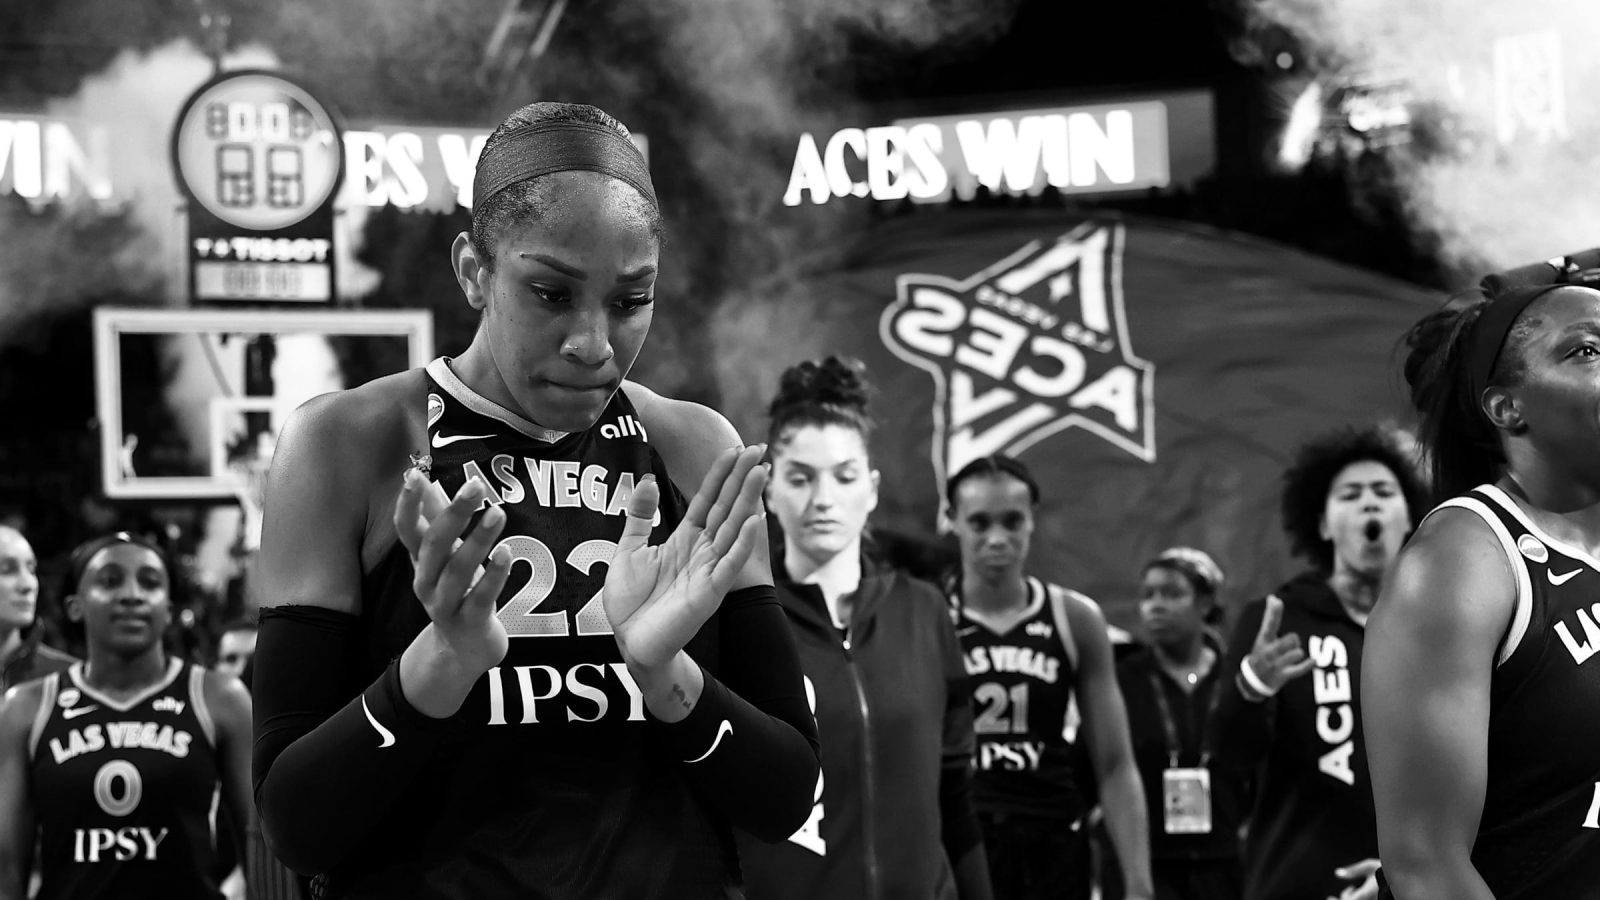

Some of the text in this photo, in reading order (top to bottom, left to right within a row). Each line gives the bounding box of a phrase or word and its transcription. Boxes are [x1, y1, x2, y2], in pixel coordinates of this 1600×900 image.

[0, 120, 112, 199] IN
[344, 131, 428, 208] ES
[784, 110, 1134, 206] ACES WIN
[431, 454, 661, 528] AS VEGA
[488, 535, 618, 638] 22
[989, 646, 1060, 684] VEGAS
[1553, 602, 1600, 665] LA
[487, 663, 648, 726] IPSY
[973, 682, 1029, 733] 21
[1308, 634, 1355, 786] ACES
[50, 721, 192, 764] LAS VEGAS
[970, 741, 1046, 770] PSY
[94, 759, 142, 817] 0
[74, 826, 169, 863] IPSY
